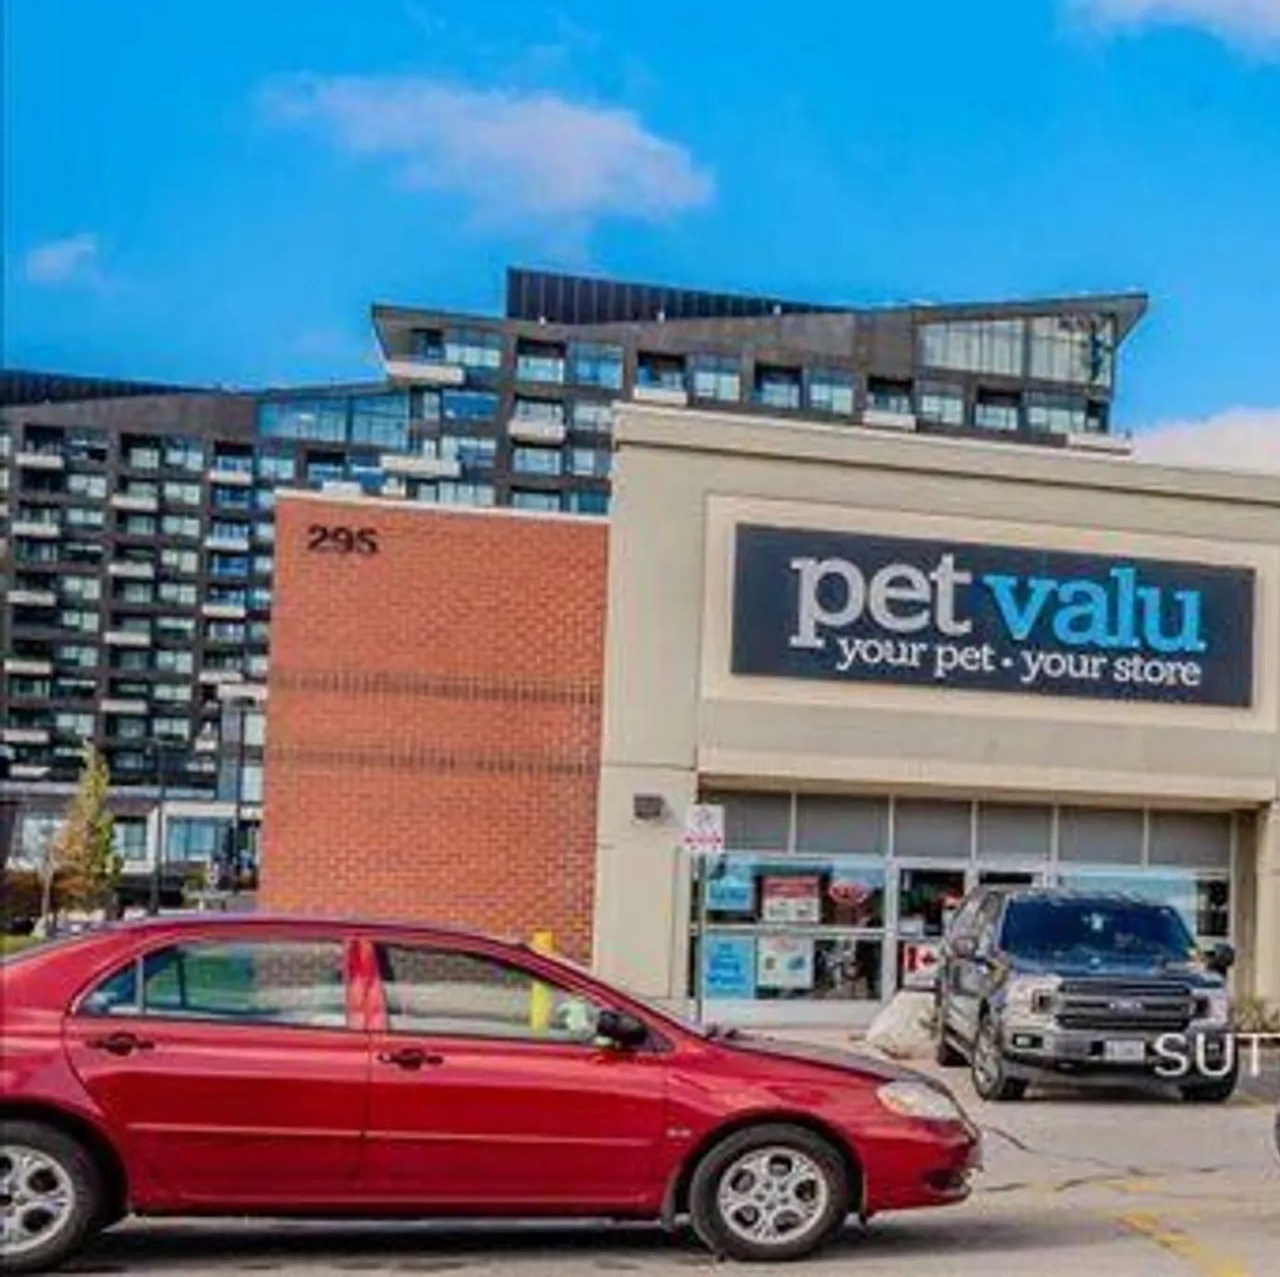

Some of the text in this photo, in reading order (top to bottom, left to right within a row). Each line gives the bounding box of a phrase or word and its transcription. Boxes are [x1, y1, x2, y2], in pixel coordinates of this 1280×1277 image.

[307, 523, 378, 557] 295
[789, 553, 1206, 653] pet valu
[835, 635, 1202, 686] your pet your store
